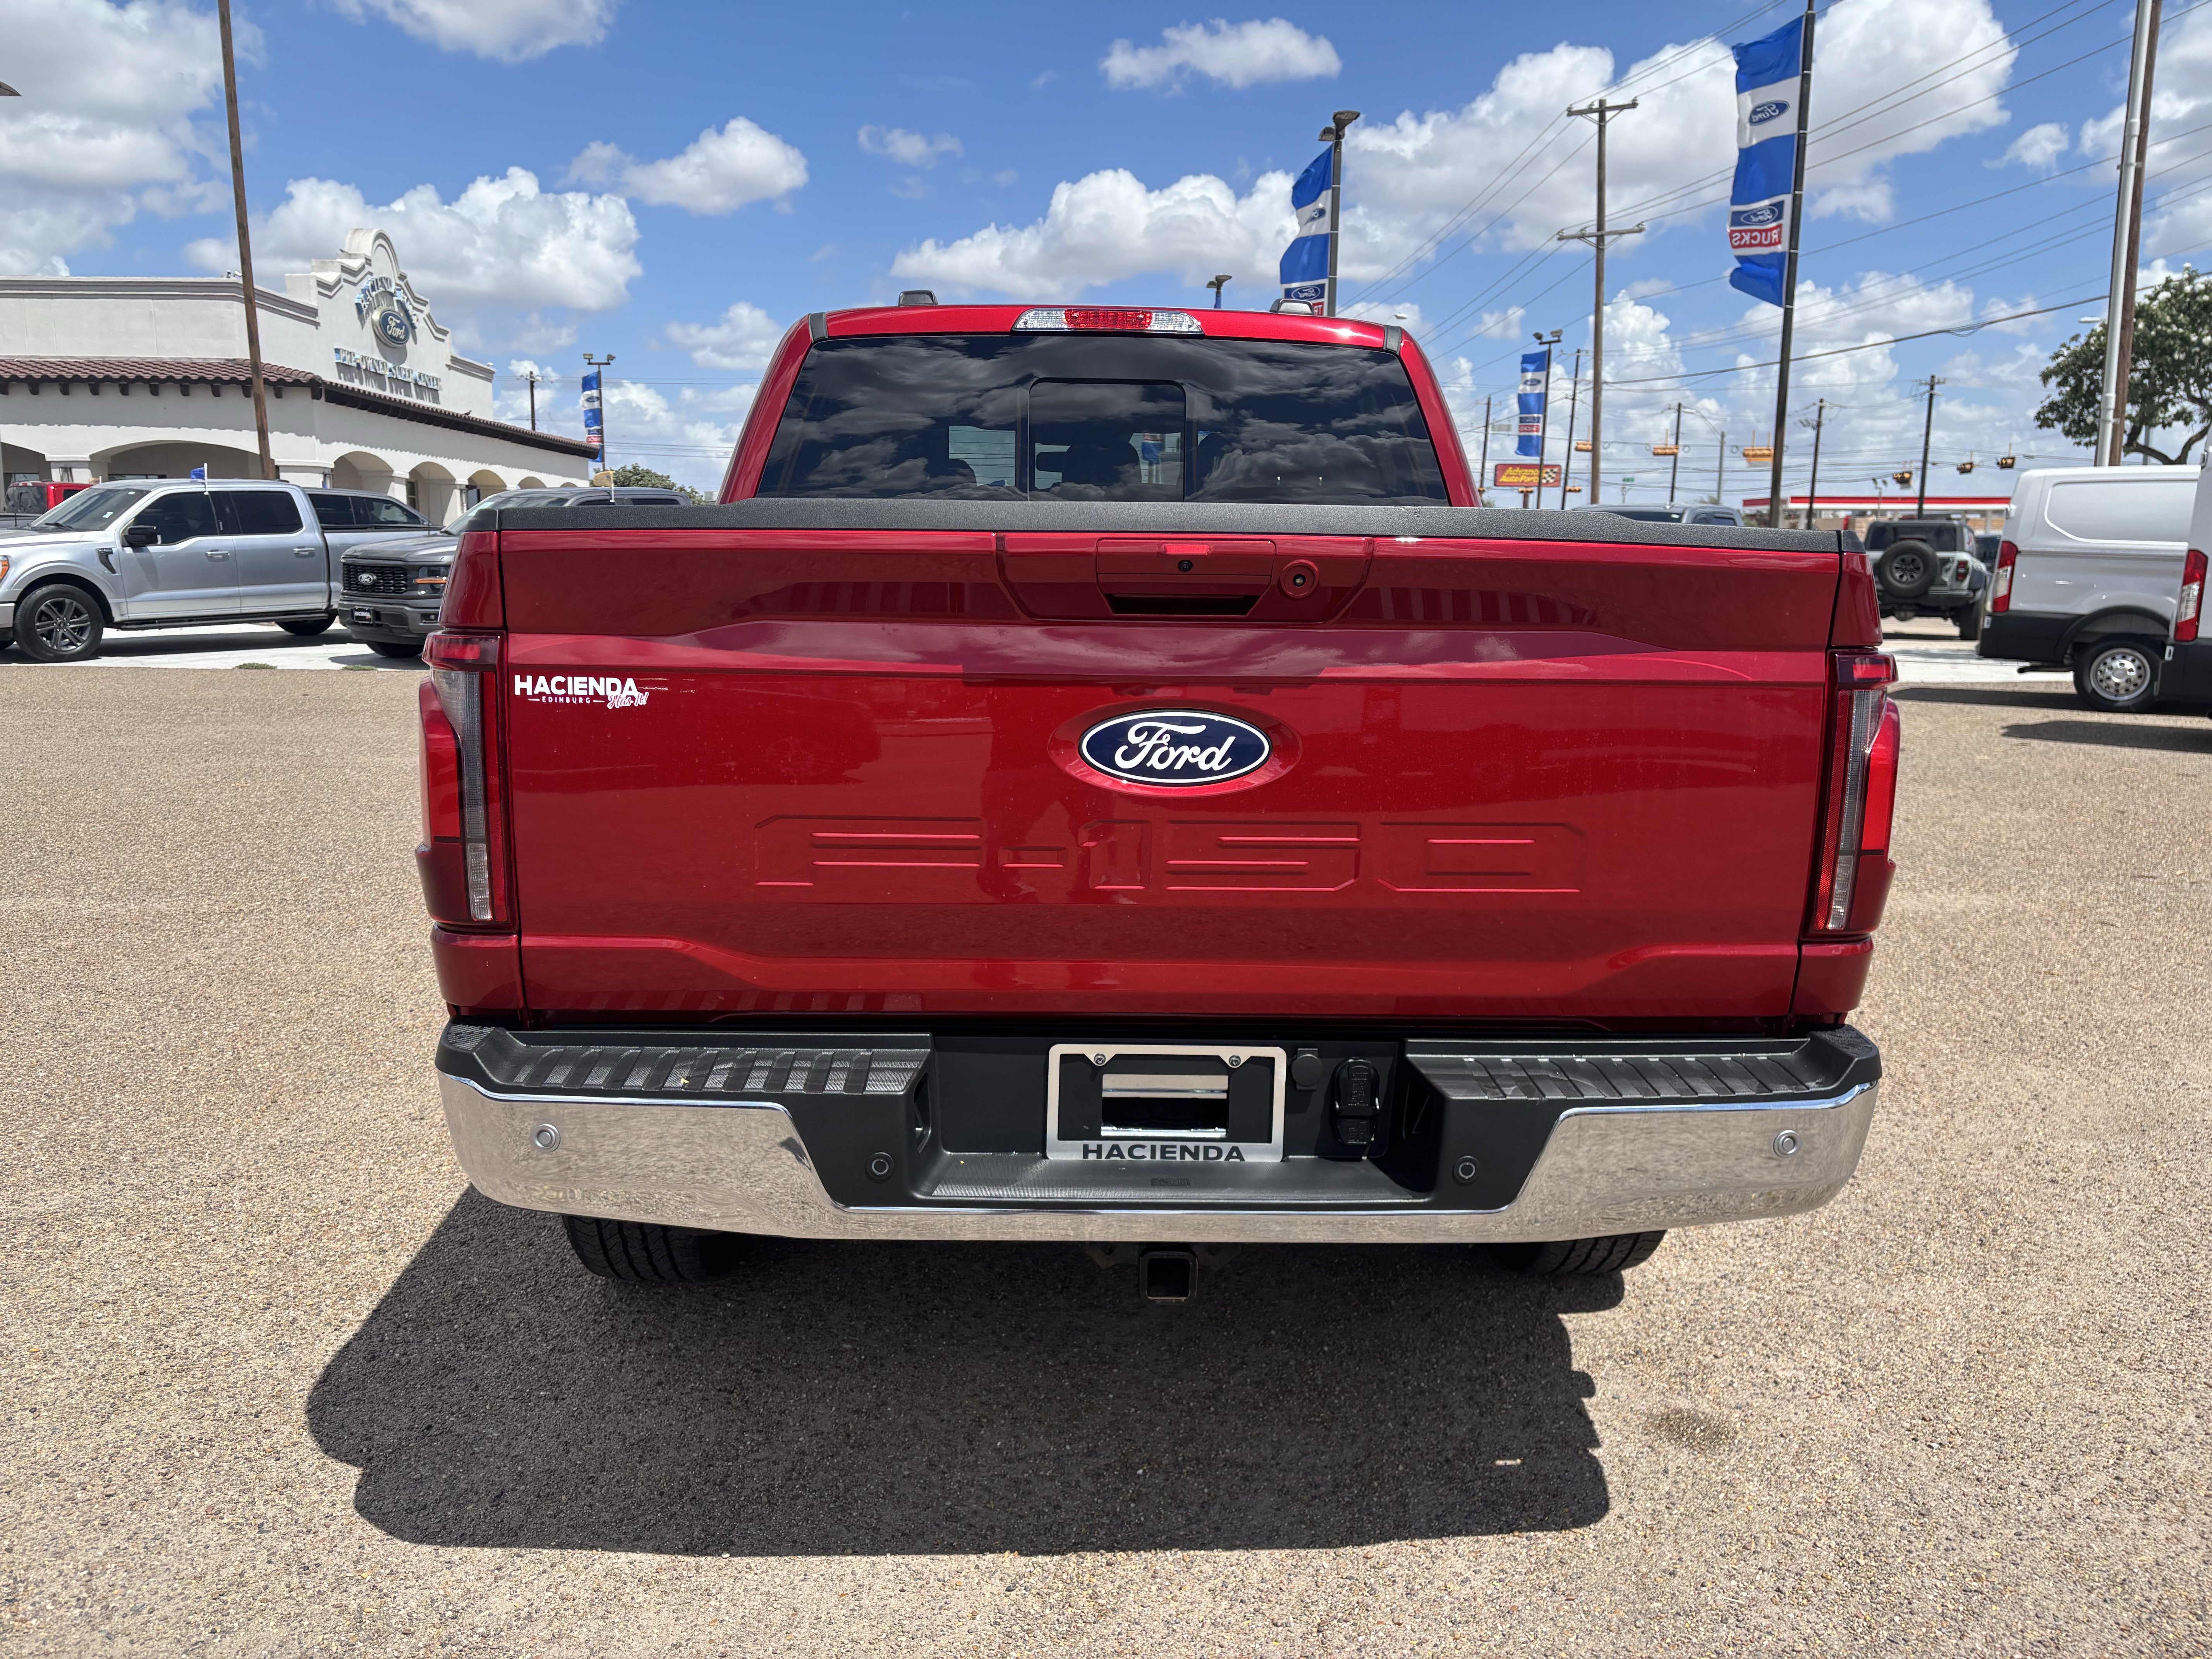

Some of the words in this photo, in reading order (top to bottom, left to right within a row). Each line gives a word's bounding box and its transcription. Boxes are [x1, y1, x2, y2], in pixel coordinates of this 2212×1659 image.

[387, 316, 405, 339] Ford
[514, 675, 639, 698] HACIENDA
[542, 696, 591, 704] EDINBURG
[607, 695, 633, 709] Has
[1115, 721, 1236, 771] Ford
[1083, 1144, 1245, 1161] HACIENDA
